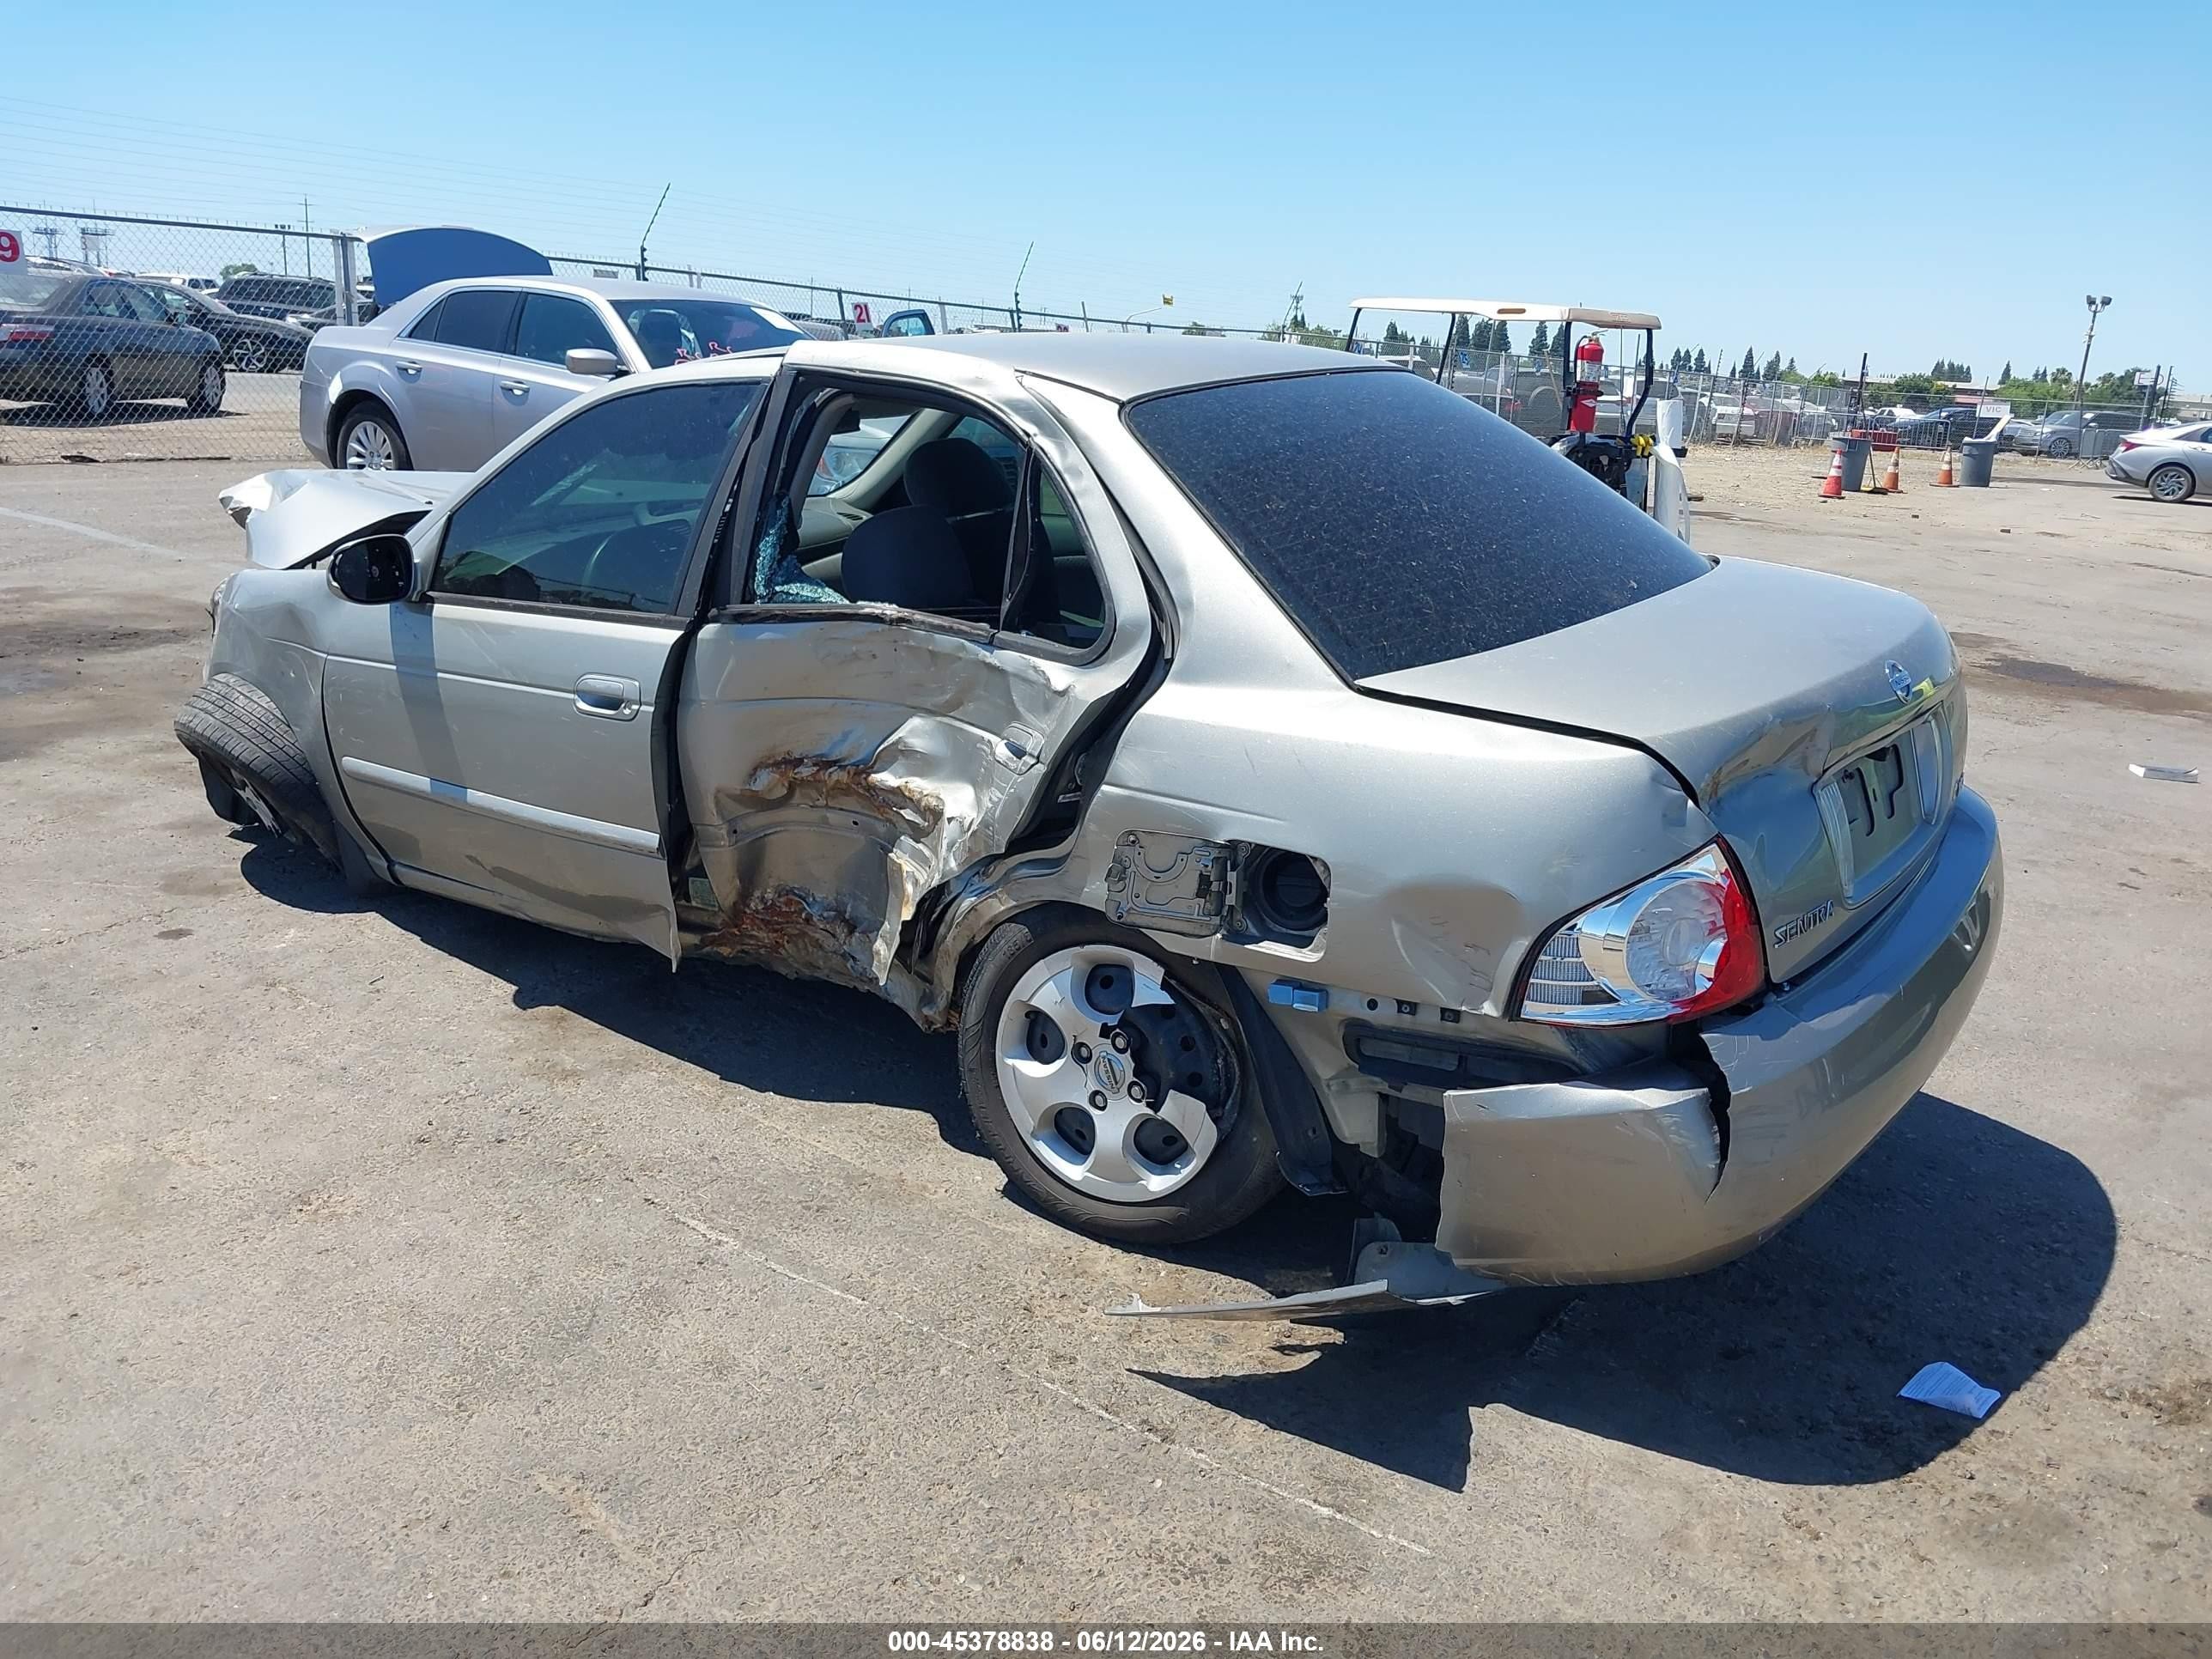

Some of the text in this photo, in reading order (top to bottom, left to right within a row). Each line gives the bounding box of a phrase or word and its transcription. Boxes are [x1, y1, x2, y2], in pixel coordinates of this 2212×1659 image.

[854, 304, 872, 324] 21
[1773, 899, 1835, 949] SENTRA
[1100, 1056, 1116, 1090] NISSAN
